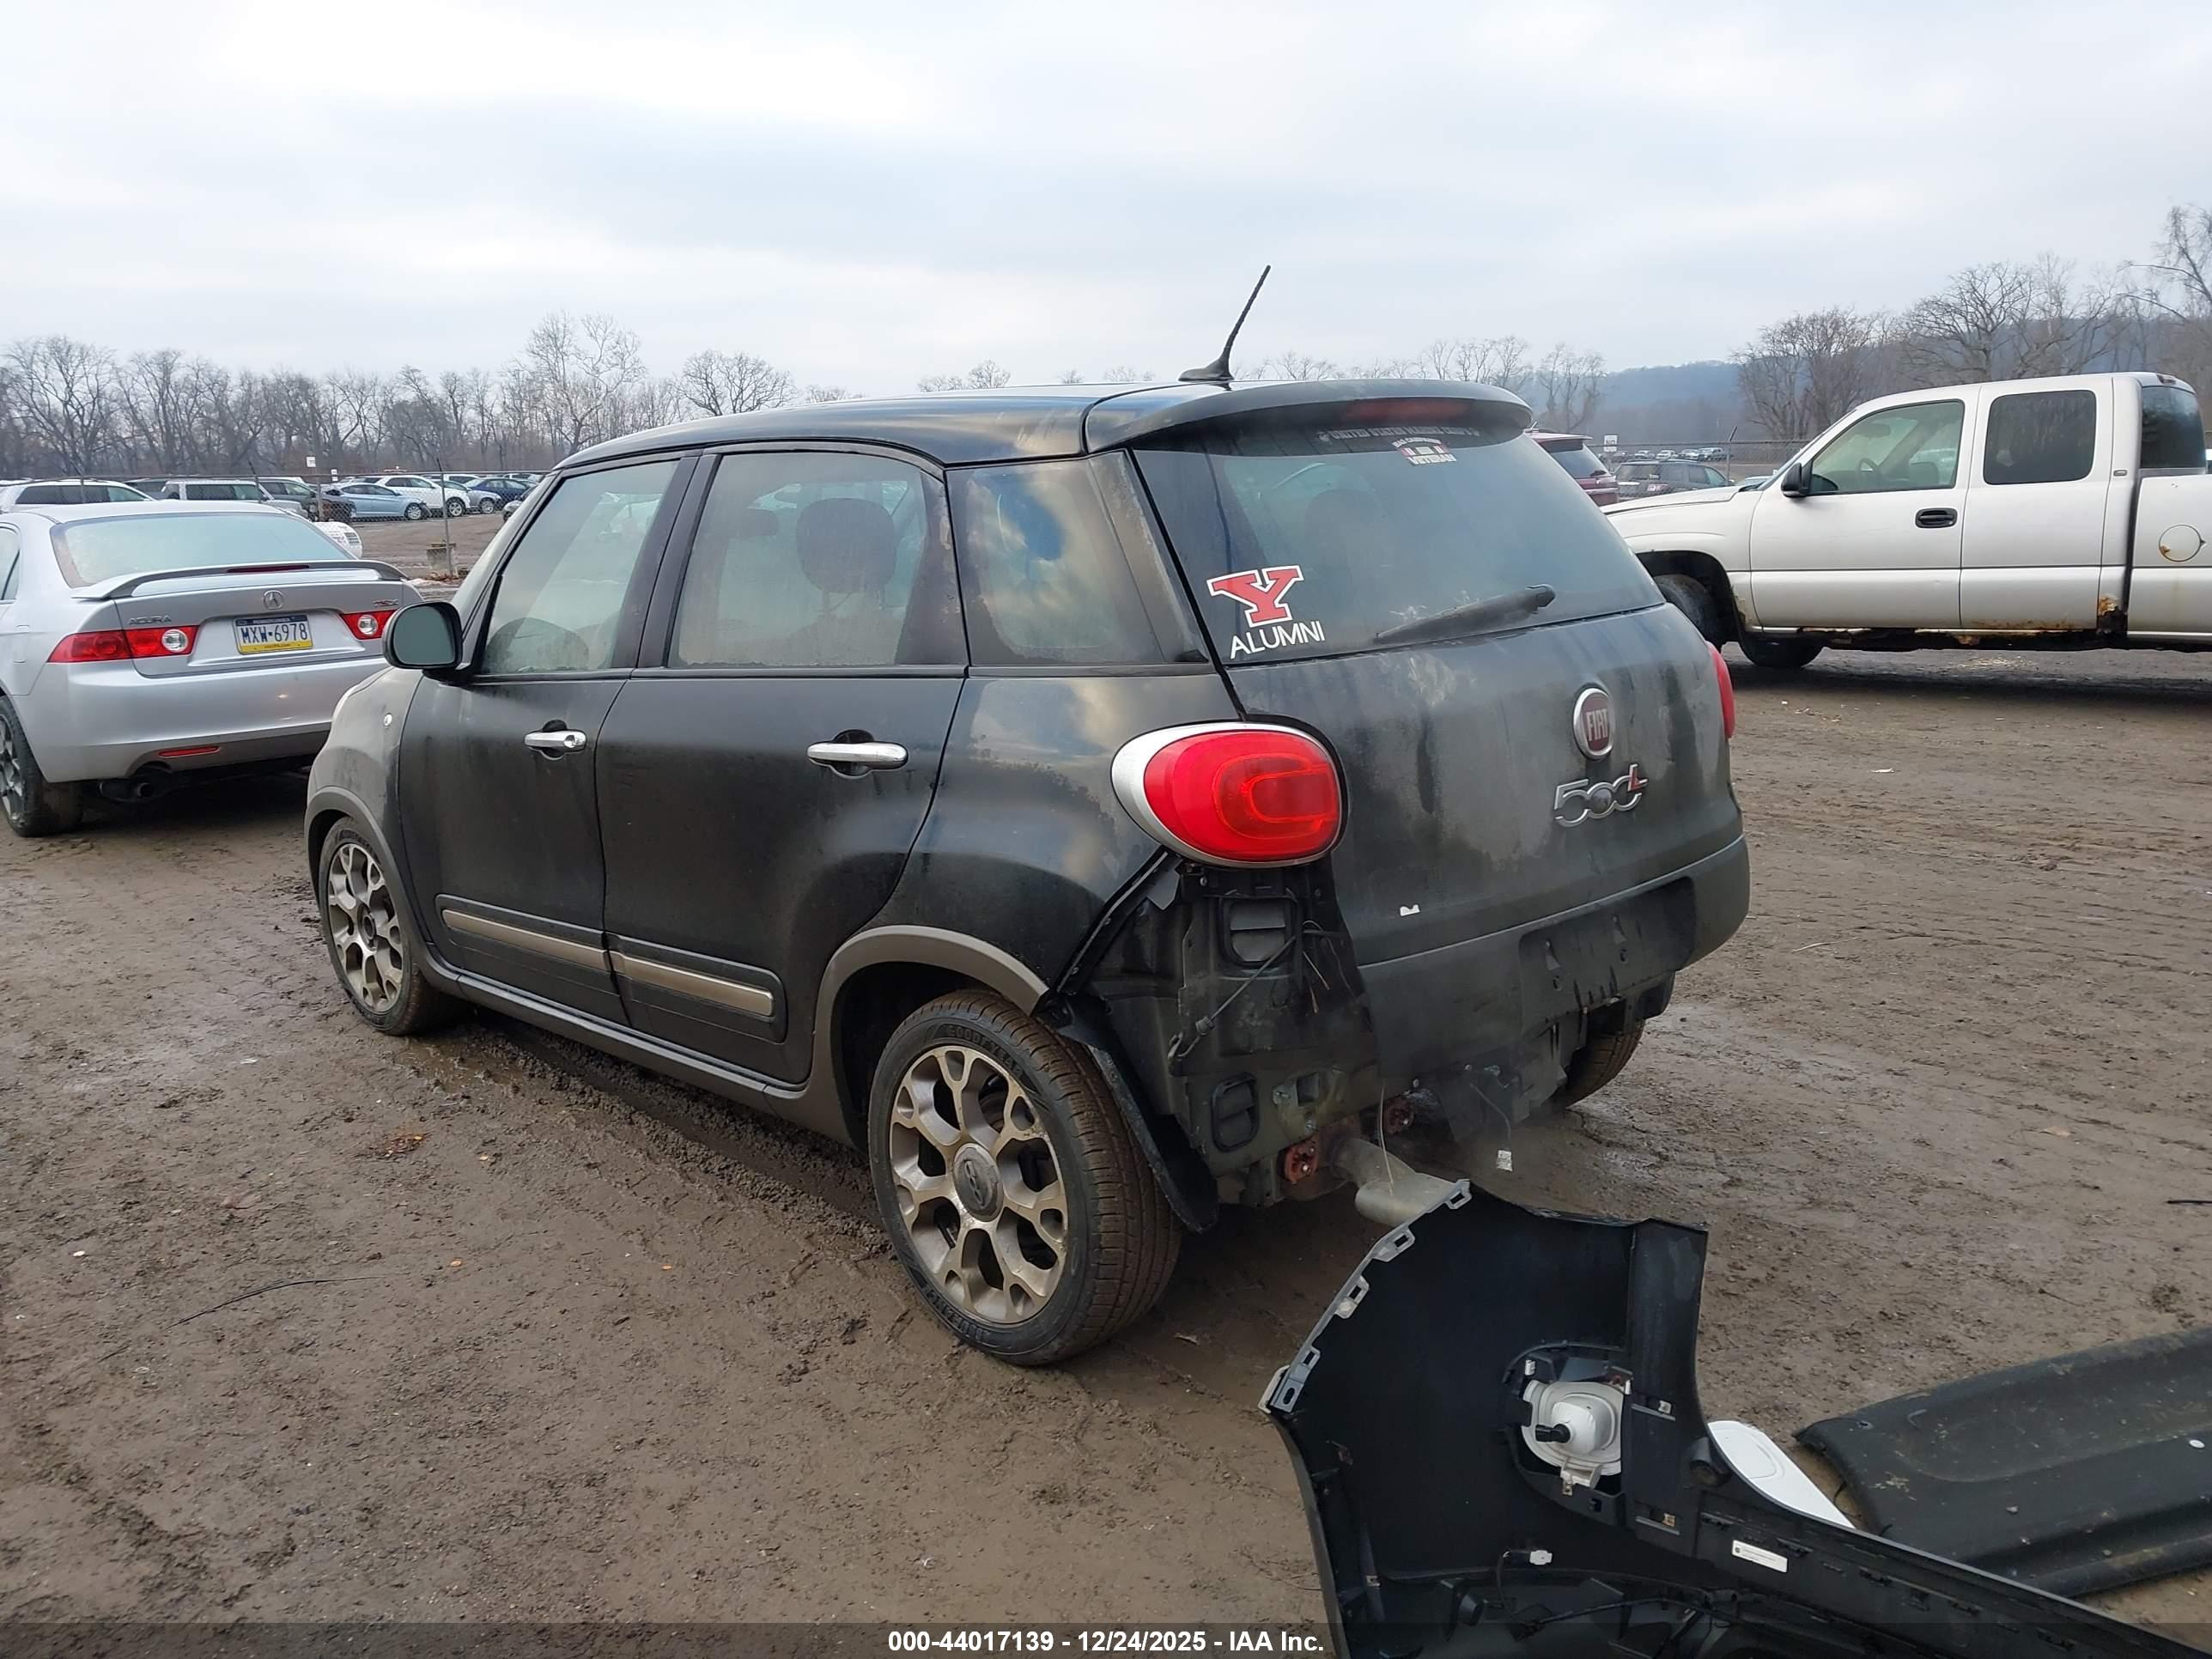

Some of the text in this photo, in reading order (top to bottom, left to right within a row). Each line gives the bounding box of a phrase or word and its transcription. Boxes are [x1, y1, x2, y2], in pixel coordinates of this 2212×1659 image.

[1206, 564, 1304, 628] Y
[1231, 620, 1326, 659] ALUMNI
[1586, 708, 1608, 742] FIAT
